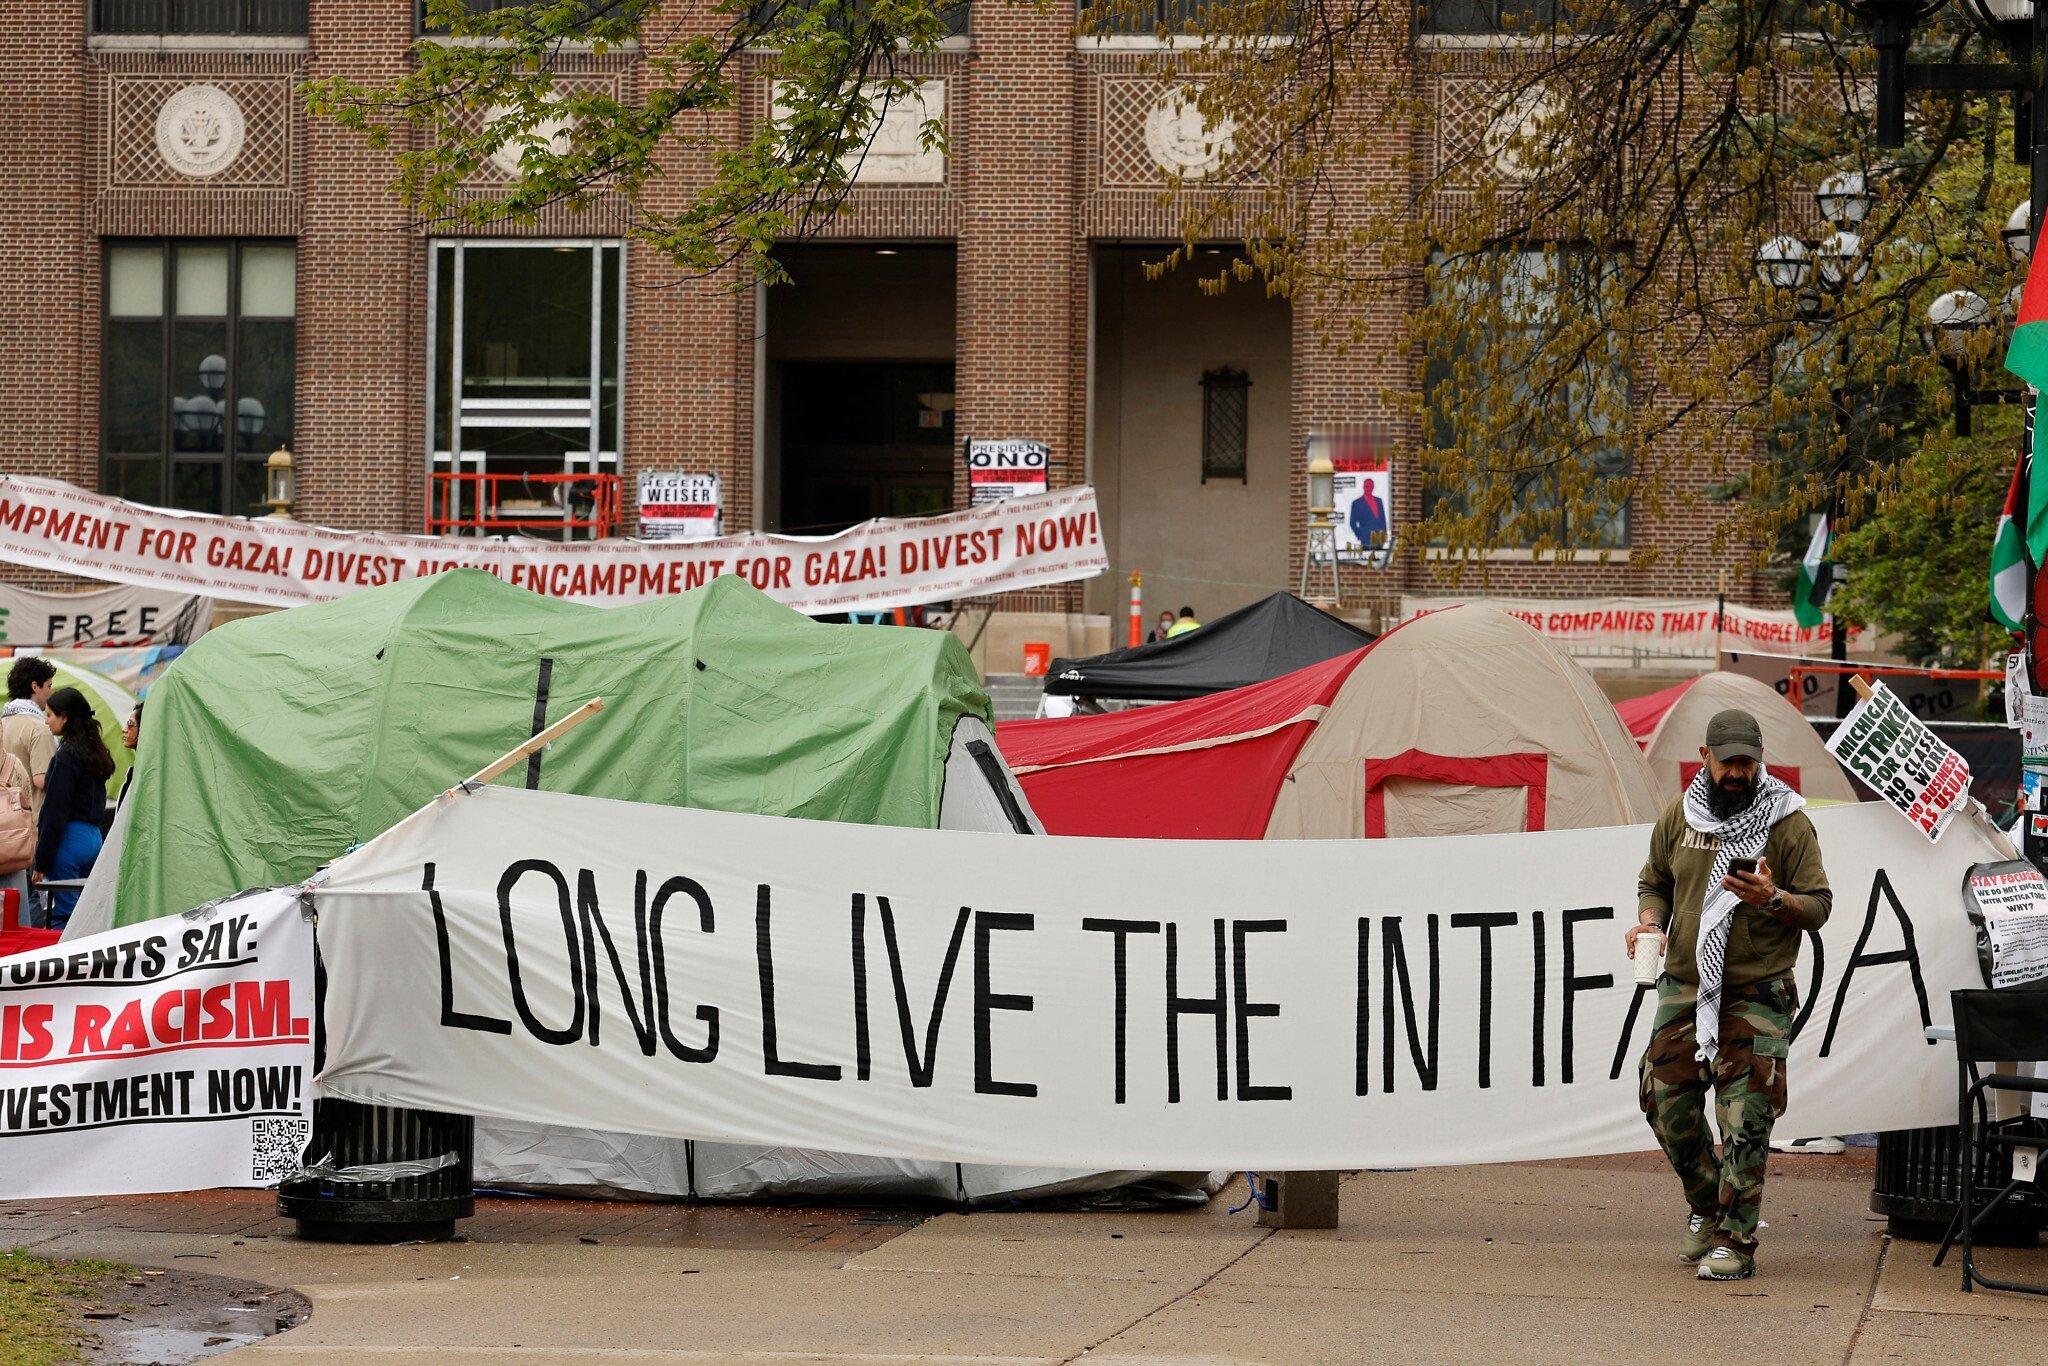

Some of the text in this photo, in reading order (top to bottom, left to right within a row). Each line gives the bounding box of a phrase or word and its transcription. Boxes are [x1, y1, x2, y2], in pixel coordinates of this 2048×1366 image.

[973, 453, 1043, 467] ONO
[9, 483, 23, 492] FREE
[25, 486, 56, 497] PALESTINE
[62, 492, 76, 501] FREE
[77, 495, 105, 508] PALESTINE
[261, 526, 275, 535] FREE
[277, 528, 308, 537] PALESTINE
[314, 531, 329, 539] FREE
[430, 541, 460, 550] PALESTINE
[560, 545, 591, 553] PALESTINE
[919, 518, 950, 528] PALESTINE
[956, 513, 969, 522] FREE
[1007, 505, 1020, 514] FREE
[1022, 500, 1053, 512] PALESTINE
[648, 488, 710, 502] WEISER
[137, 528, 197, 563] FOR
[207, 536, 293, 577] GAZA!
[302, 548, 406, 587] DIVEST
[511, 560, 725, 597] ENCAMPMENT
[736, 556, 791, 590] FOR
[804, 545, 886, 587] GAZA!
[901, 528, 1003, 575] DIVEST
[1016, 512, 1097, 557] NOW!
[109, 563, 122, 571] FREE
[124, 565, 155, 576] PALESTINE
[161, 572, 175, 580] FREE
[213, 580, 227, 588] FREE
[228, 583, 258, 592] PALESTINE
[264, 587, 278, 595] FREE
[279, 589, 310, 599] PALESTINE
[829, 594, 859, 605] PALESTINE
[1022, 567, 1036, 576] FREE
[1037, 562, 1068, 574] PALESTINE
[47, 607, 159, 642] FREE
[1548, 609, 1656, 632] COMPANIES
[1662, 611, 1707, 633] THAT
[1745, 620, 1792, 643] PEOPLE
[1796, 626, 1811, 642] IN
[1836, 686, 1893, 761] MICHIGAN
[1850, 700, 1910, 779] STRIKE
[1869, 721, 1924, 791] FOR GAZA
[1884, 731, 1936, 802] NO CLASS
[1895, 741, 1949, 812] NO WORK
[1907, 752, 1960, 822] NO BUSINESS
[1919, 763, 1969, 834] AS USUAL
[1970, 875, 1998, 888] STAY
[1977, 889, 1990, 897] WE
[1992, 887, 2001, 896] DO
[2003, 886, 2018, 894] NOT
[1980, 896, 2001, 905] WITH
[2007, 902, 2034, 912] WHY?
[178, 914, 258, 969] SAY:
[1990, 921, 1995, 930] 1
[1993, 944, 2000, 953] 2
[422, 858, 720, 1064] LONG
[755, 883, 1038, 1097] LIVE
[1082, 917, 1292, 1104] THE
[0, 979, 309, 1060] IS RACISM.
[208, 1066, 302, 1114] NOW!
